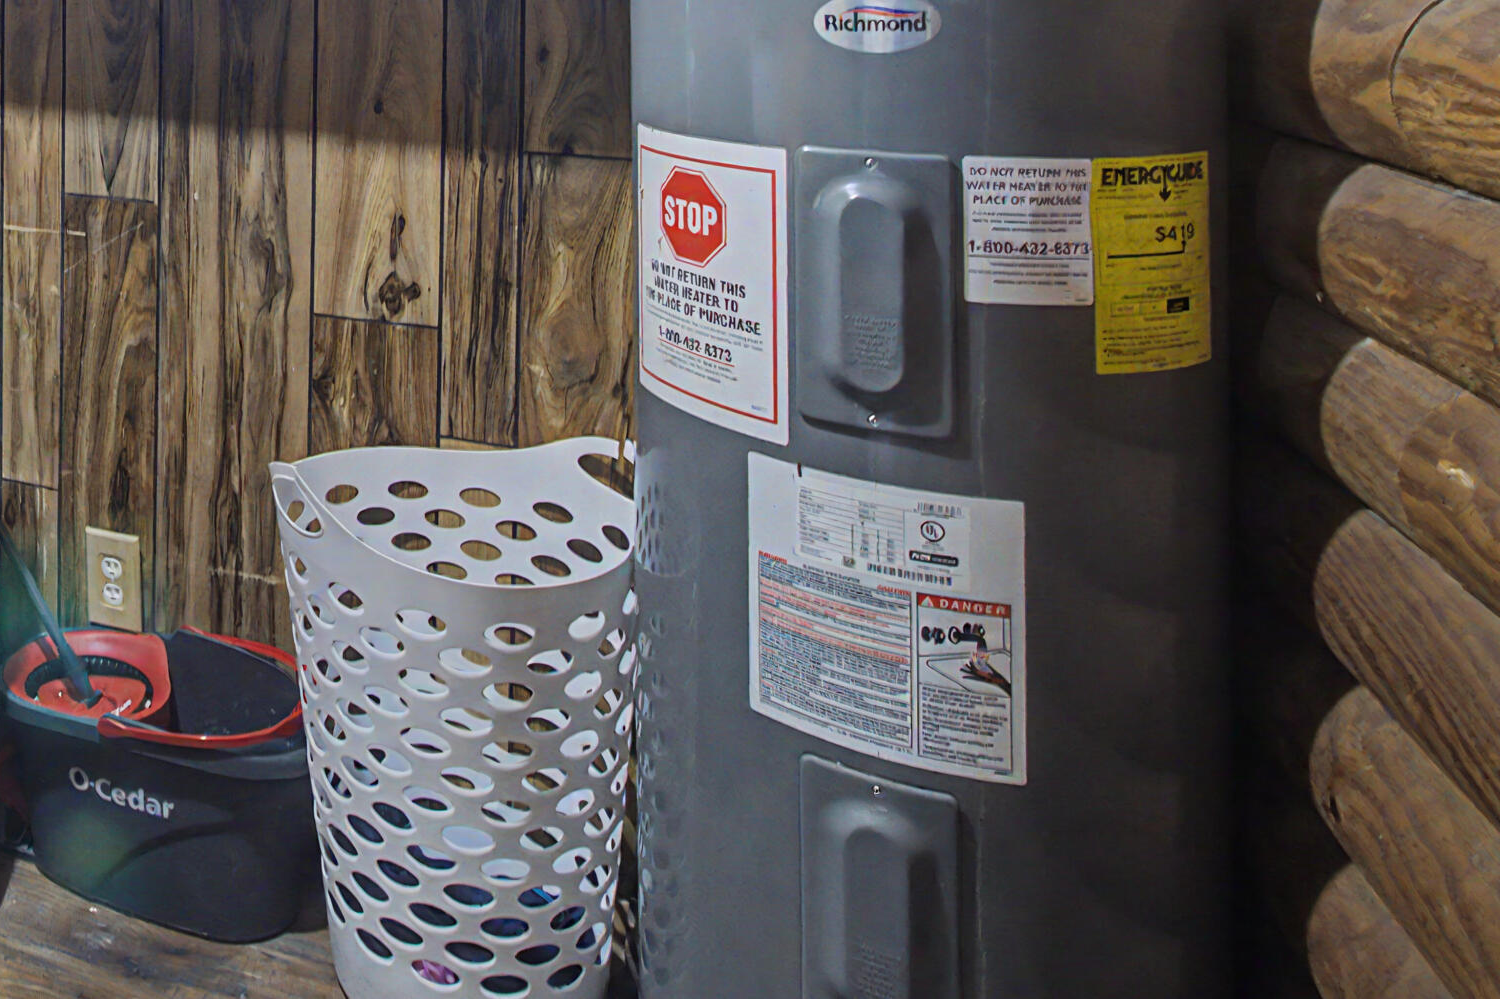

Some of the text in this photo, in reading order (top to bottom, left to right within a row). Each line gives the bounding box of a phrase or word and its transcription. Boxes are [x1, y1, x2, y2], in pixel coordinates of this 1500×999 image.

[824, 10, 927, 32] Richmond
[969, 167, 987, 176] DO
[990, 167, 1014, 177] NOT
[1017, 168, 1061, 178] RETURN
[966, 181, 1006, 192] WATER
[1009, 181, 1051, 192] HEATER
[973, 195, 1007, 205] PLACE
[1010, 196, 1025, 205] OF
[663, 195, 718, 236] STOP
[677, 268, 716, 291] RETURN
[720, 280, 746, 299] THIS
[682, 285, 721, 308] HEATER
[724, 298, 739, 313] TO
[657, 291, 681, 313] PLACE
[684, 303, 696, 316] OF
[698, 307, 762, 336] PURCHASE
[940, 599, 1007, 616] DANGER
